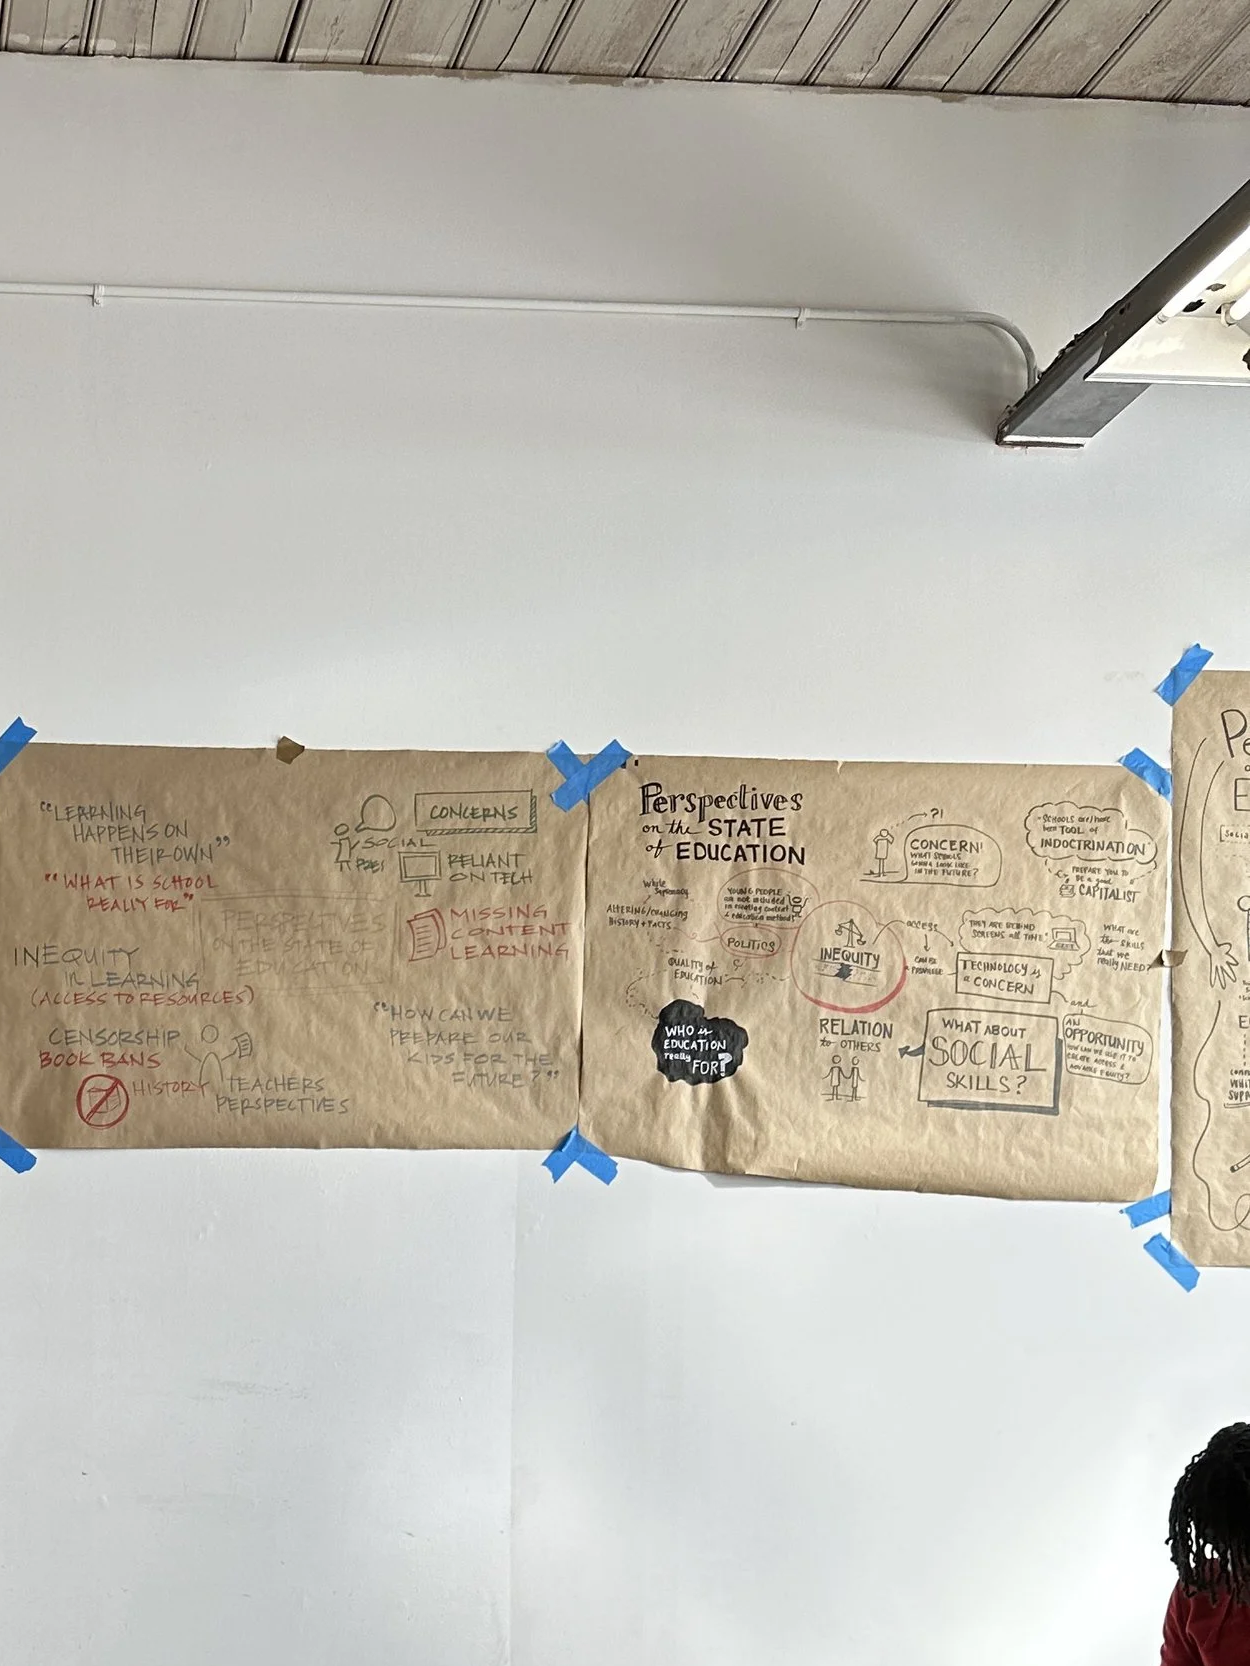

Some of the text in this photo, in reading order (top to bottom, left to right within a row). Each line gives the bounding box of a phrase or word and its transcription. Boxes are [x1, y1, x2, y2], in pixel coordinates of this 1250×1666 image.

[639, 782, 803, 823] Perspectives
[430, 806, 518, 822] CONCERNS
[73, 820, 188, 844] HAPPENS ON
[642, 817, 786, 838] on the STATE
[1060, 826, 1084, 835] TOOL
[361, 837, 437, 849] SOCIAL
[111, 846, 171, 865] THEIR
[447, 853, 527, 869] RELIANT
[646, 839, 805, 866] of EDUCATION
[153, 874, 219, 890] SCHOOL
[491, 869, 533, 885] TECH
[1079, 884, 1141, 903] CAPITALIST
[87, 897, 148, 912] REALLY
[450, 904, 548, 921] MISSING
[221, 909, 386, 933] PERSPECTIVES
[906, 921, 938, 932] ACCESS
[1103, 924, 1125, 934] WHAT
[452, 922, 571, 940] CONTENT
[450, 944, 570, 960] LEARNING
[727, 937, 776, 952] POLITICS
[1120, 939, 1145, 950] SKILLS
[14, 946, 139, 968] INEQUITY
[668, 958, 703, 971] QUALITY
[820, 947, 881, 969] INEQUITY
[1097, 958, 1151, 972] really NEED?
[236, 959, 368, 976] EDUCATION
[959, 959, 1028, 977] TECHNOLOGY
[91, 972, 199, 990] LEARNING
[674, 971, 723, 986] EDUCATION
[974, 976, 1035, 995] CONCERN
[31, 986, 255, 1008] (ACCESS RESOURCES)
[1070, 999, 1097, 1008] and
[439, 1007, 514, 1022] CAN WE
[665, 1025, 713, 1038] WHO is
[820, 1019, 893, 1039] RELATION
[942, 1018, 1027, 1039] WHAT ABOUT
[49, 1028, 180, 1047] CENSORSHIP
[390, 1029, 532, 1046] PREPARE OUR
[663, 1039, 726, 1051] EDUCATION
[840, 1040, 881, 1052] OTHERS
[1065, 1027, 1144, 1057] OPPORTUNITY
[39, 1051, 161, 1069] BOOK BANS
[512, 1053, 553, 1066] THE
[664, 1051, 692, 1062] really
[929, 1035, 1047, 1072] SOCIAL
[132, 1080, 209, 1097] HISTORY
[226, 1076, 325, 1093] TEACHERS
[946, 1072, 1028, 1095] SKILLS?
[215, 1097, 350, 1115] PERSPECTIVES
